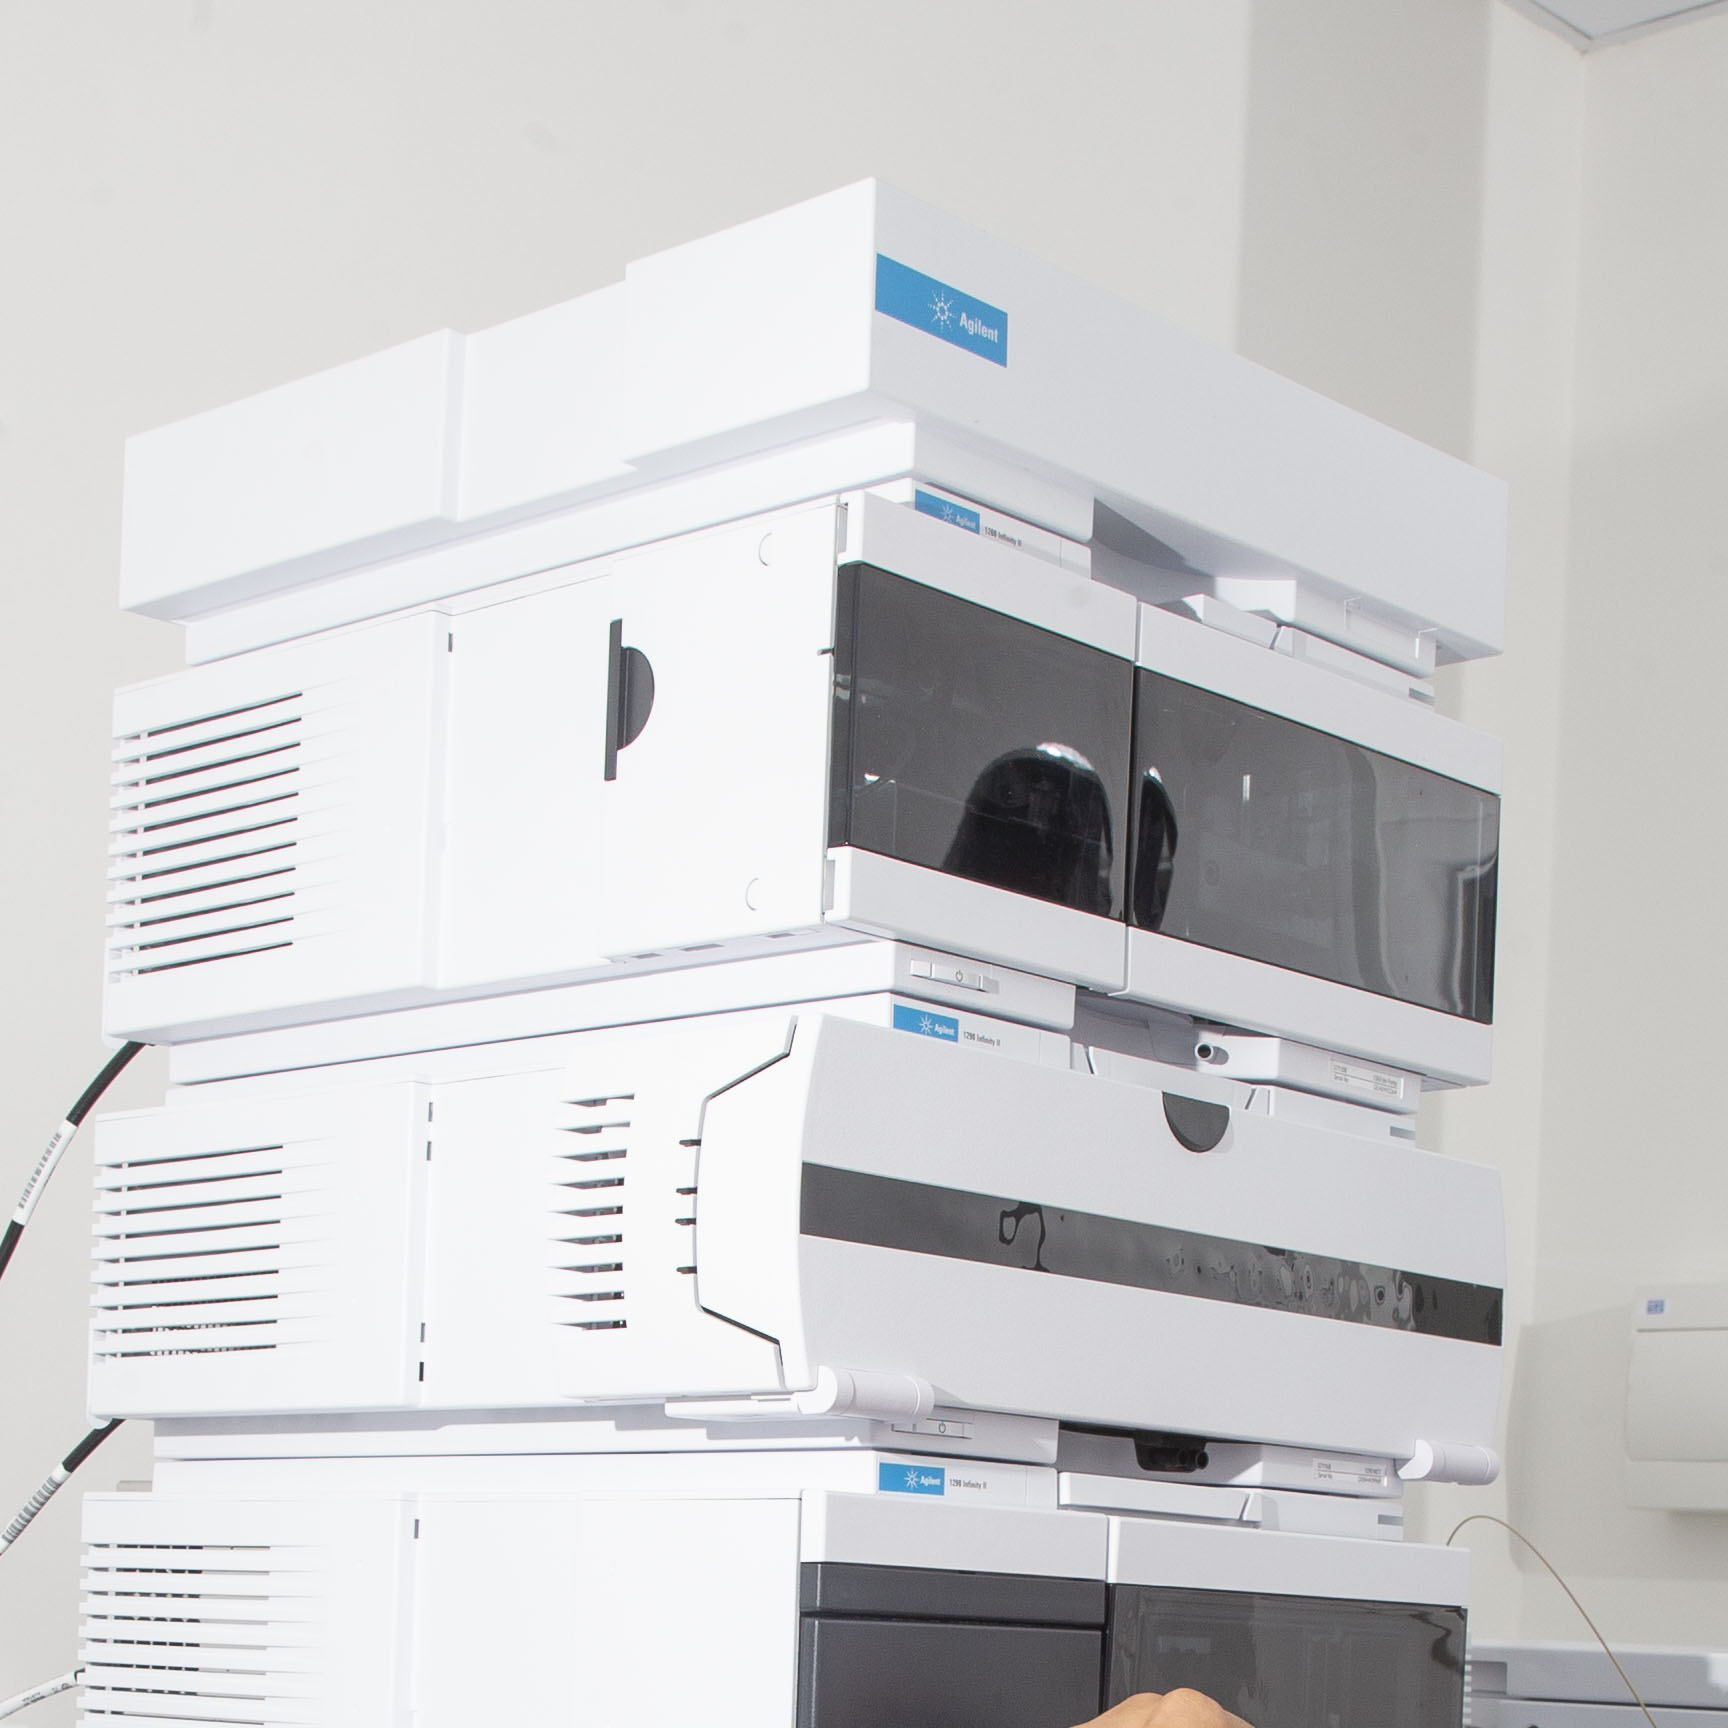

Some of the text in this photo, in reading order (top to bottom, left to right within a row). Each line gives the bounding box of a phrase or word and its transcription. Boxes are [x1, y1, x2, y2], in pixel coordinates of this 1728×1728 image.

[959, 311, 999, 344] Agilent
[955, 514, 977, 530] Agilent
[934, 1023, 955, 1036] Agilent
[919, 1475, 942, 1487] Agilent
